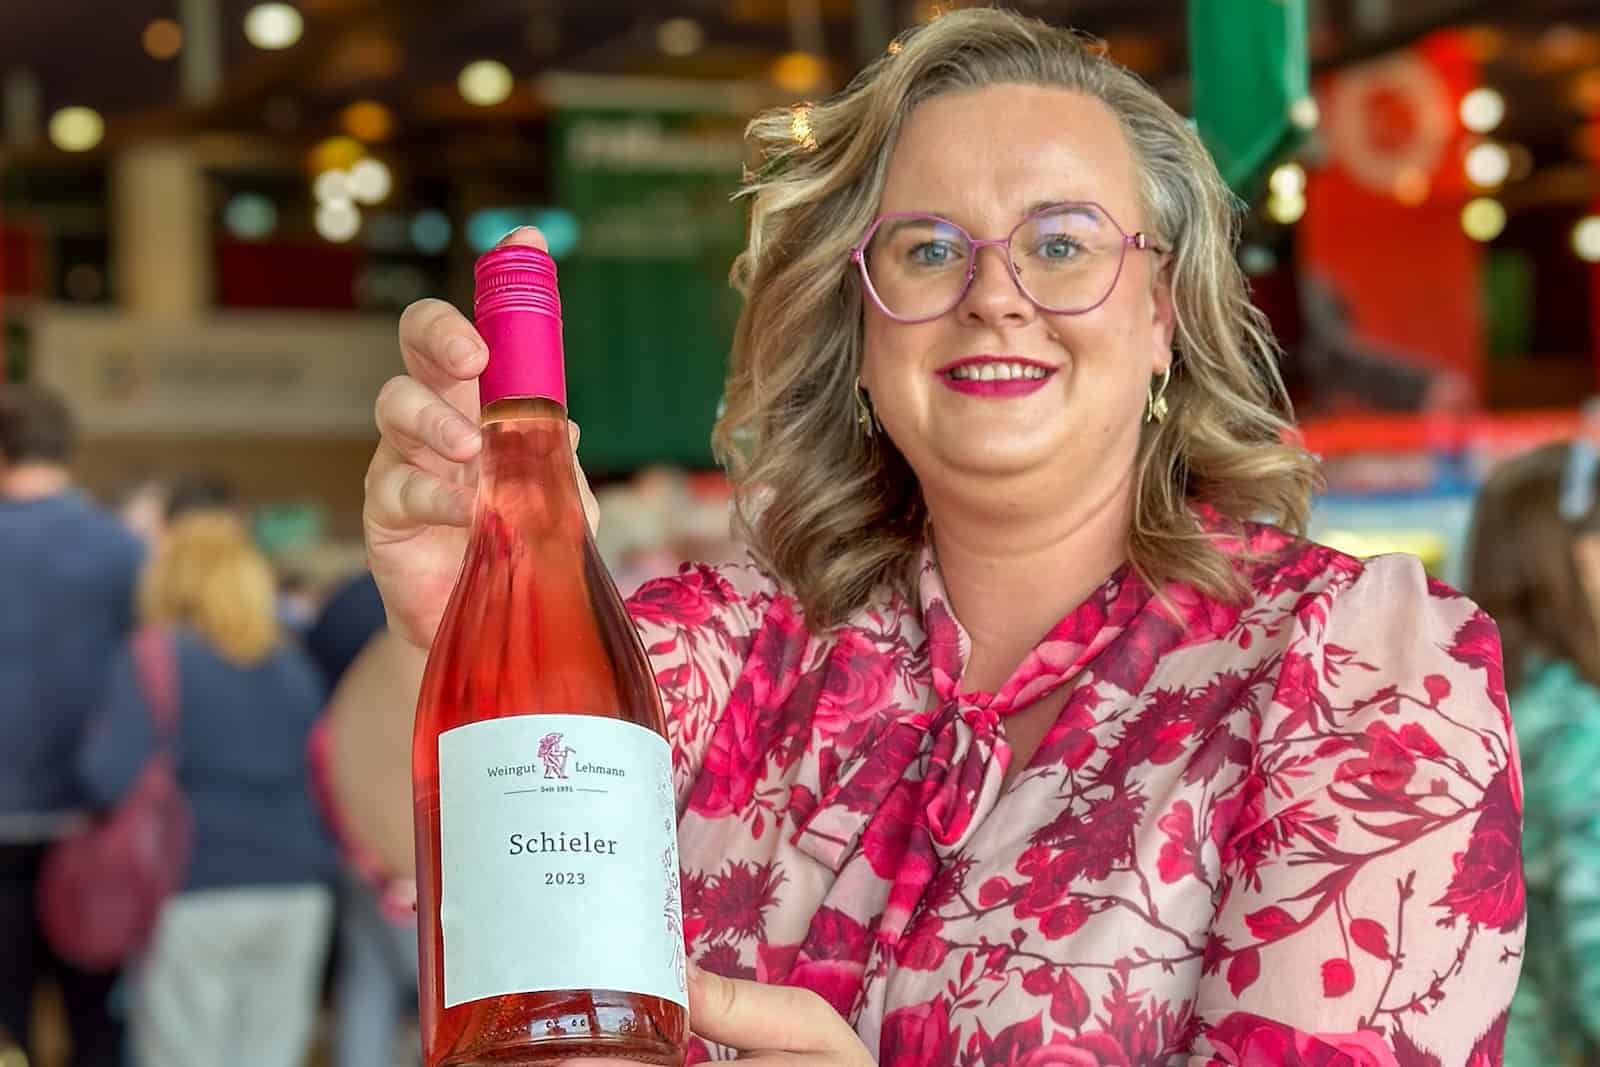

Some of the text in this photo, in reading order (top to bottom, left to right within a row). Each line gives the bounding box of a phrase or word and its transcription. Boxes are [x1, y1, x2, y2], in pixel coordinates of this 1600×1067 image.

[487, 761, 625, 778] Weingut Lehmann
[540, 785, 555, 793] Seit
[509, 831, 617, 855] Schieler
[544, 872, 586, 885] 2023
